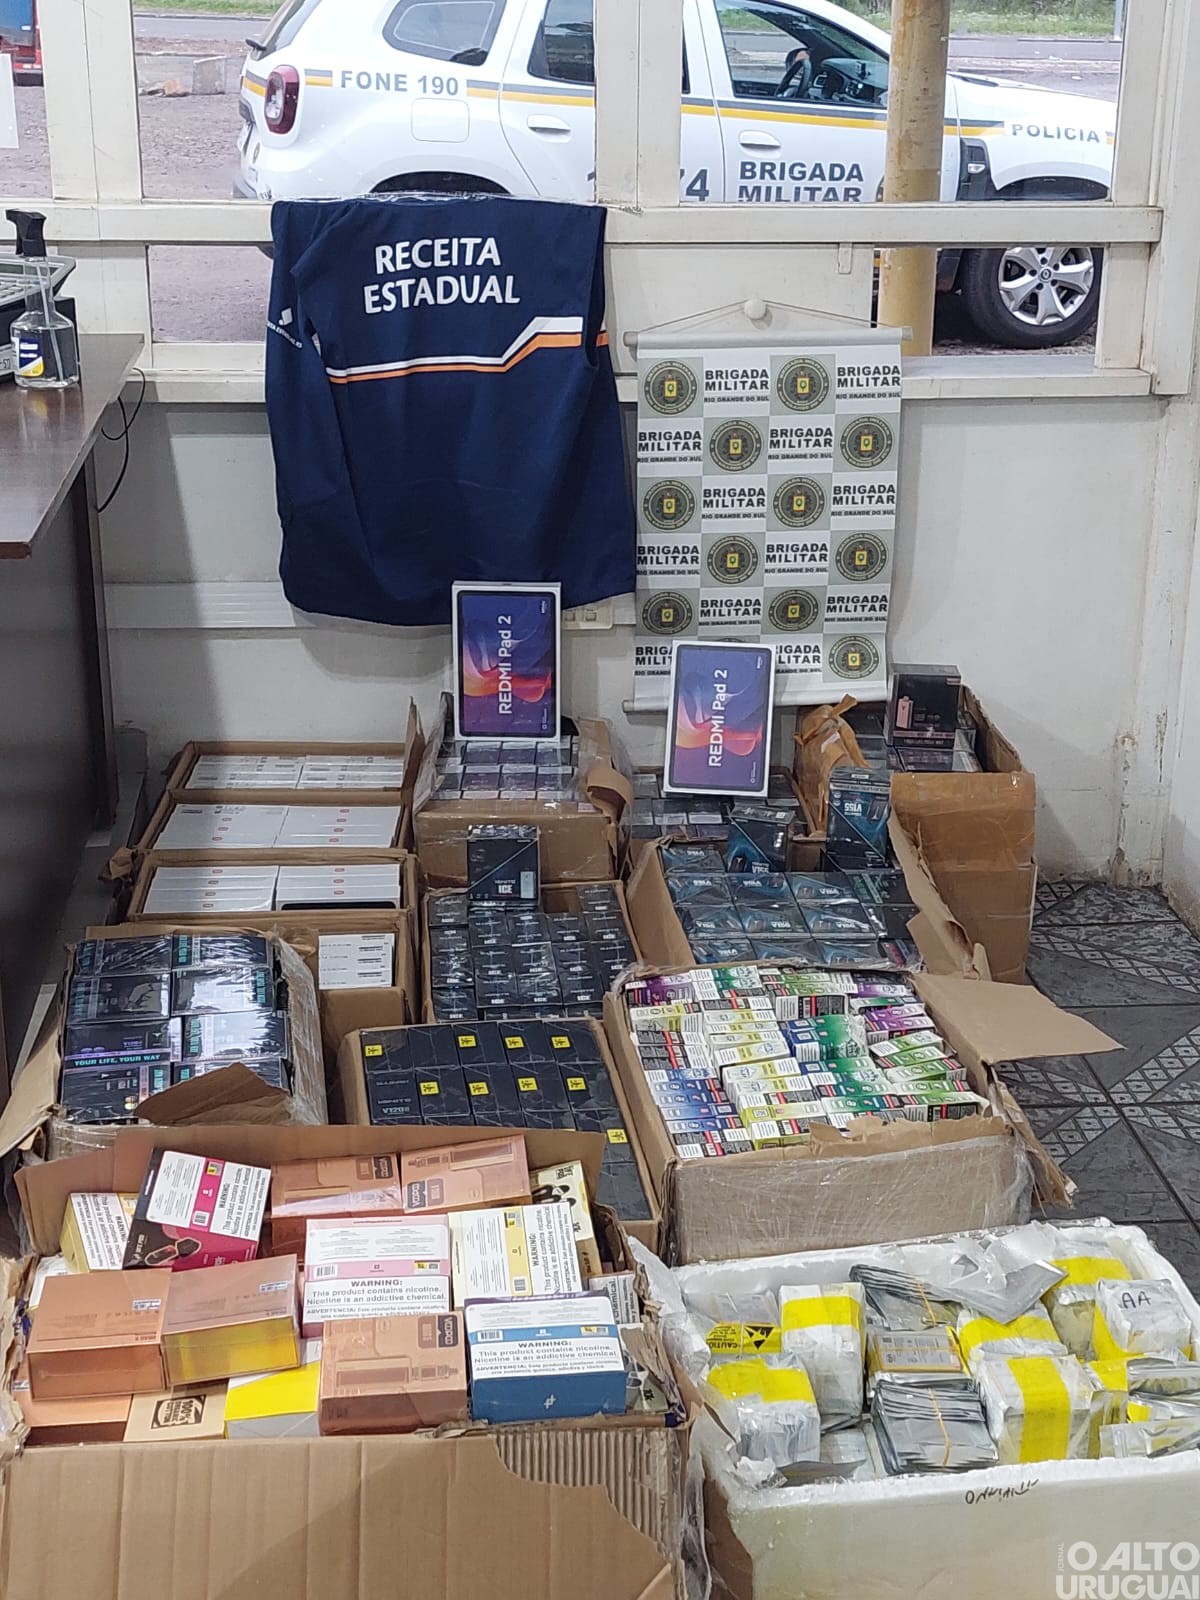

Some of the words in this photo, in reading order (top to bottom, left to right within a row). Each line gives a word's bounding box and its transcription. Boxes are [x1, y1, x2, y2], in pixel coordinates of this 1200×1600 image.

[340, 70, 408, 90] FONE
[418, 76, 459, 96] 190
[1012, 123, 1100, 144] POLICIA
[739, 161, 864, 182] BRIGADA
[738, 185, 862, 202] MILITAR
[375, 237, 501, 274] RECEITA
[363, 274, 521, 315] ESTADUAL
[705, 369, 769, 380] BRIGADA
[837, 365, 900, 376] BRIGADA
[705, 380, 769, 391] MILITAR
[837, 376, 900, 388] MILITAR
[638, 431, 701, 441] BRIGADA
[770, 427, 833, 438] BRIGADA
[638, 441, 701, 451] MILITAR
[770, 438, 833, 448] MILITAR
[703, 487, 766, 498] BRIGADA
[833, 484, 895, 495] BRIGADA
[703, 497, 766, 508] MILITAR
[833, 495, 895, 505] MILITAR
[637, 545, 699, 555] BRIGADA
[766, 543, 828, 553] BRIGADA
[637, 555, 699, 565] MILITAR
[766, 552, 828, 563] MILITAR
[701, 598, 761, 608] BRIGADA
[827, 595, 888, 604] BRIGADA
[700, 607, 761, 617] MILITAR
[826, 603, 887, 613] MILITAR
[499, 615, 512, 625] 2
[499, 631, 513, 658] Pad
[635, 655, 672, 665] MILIT
[777, 654, 821, 664] LITAR
[715, 669, 728, 679] 2
[499, 671, 512, 714] REDMI
[712, 685, 727, 711] Pad
[709, 719, 725, 767] REDMI
[518, 1340, 572, 1348] WARNING:
